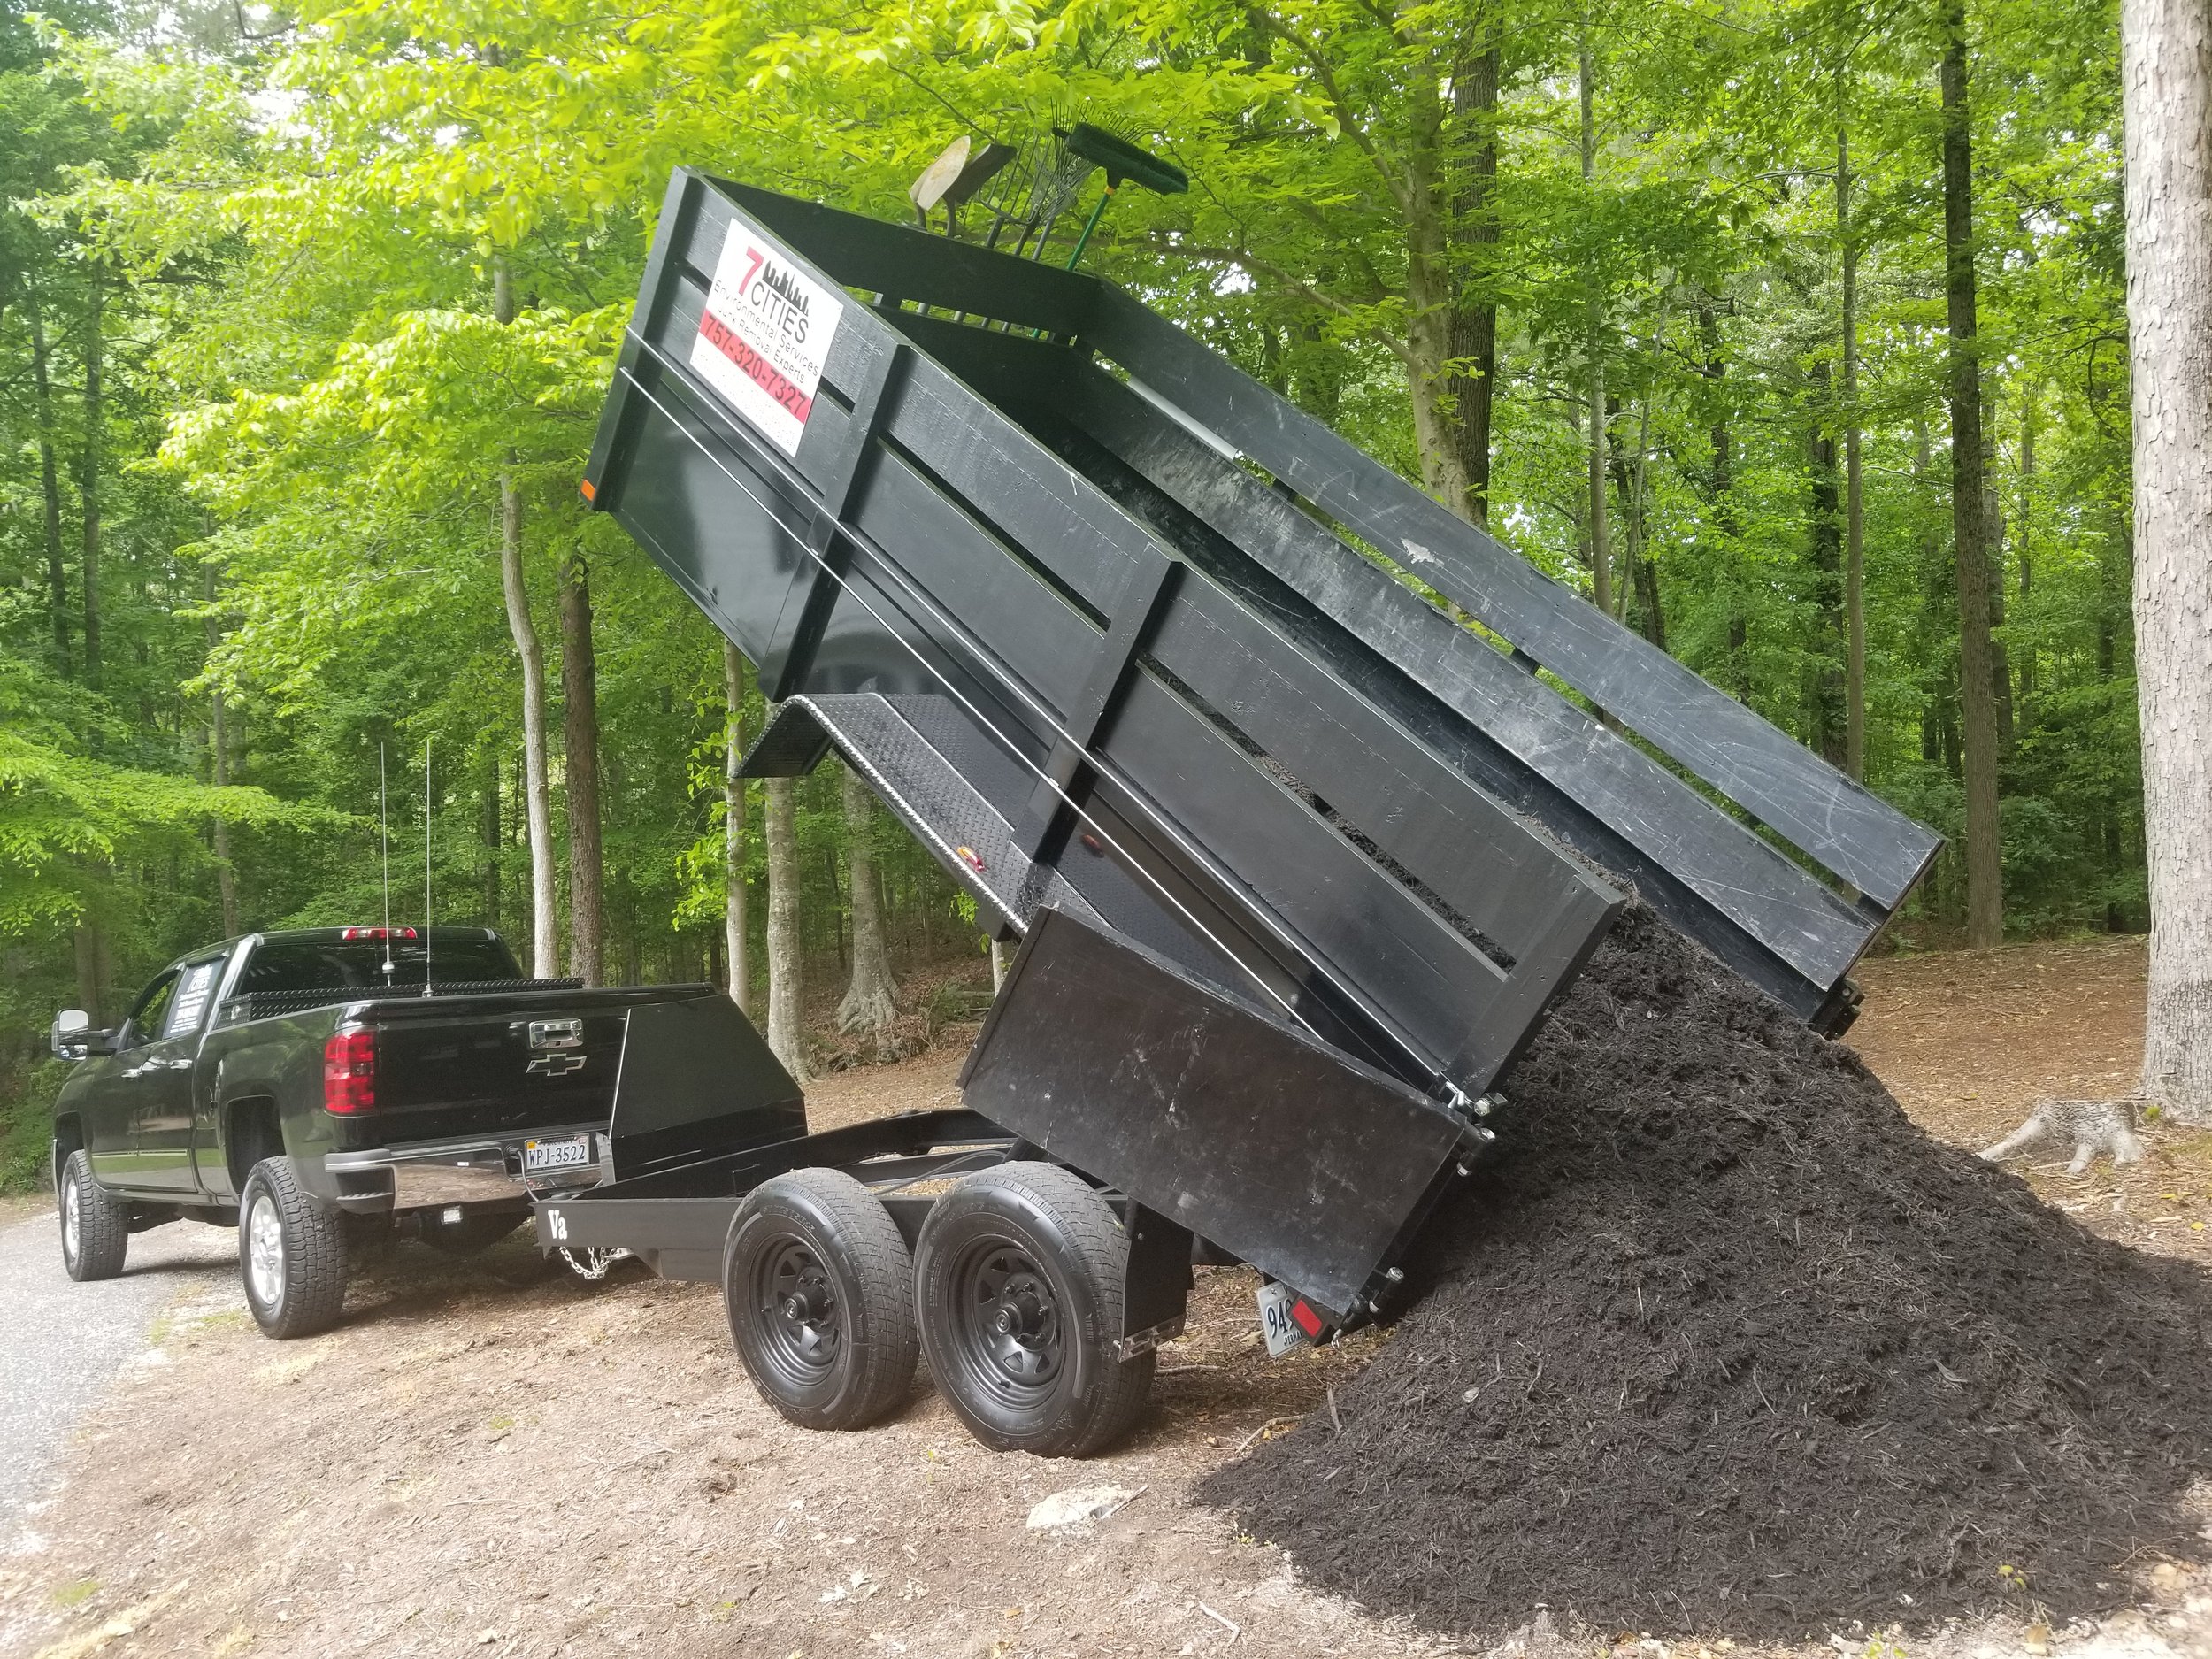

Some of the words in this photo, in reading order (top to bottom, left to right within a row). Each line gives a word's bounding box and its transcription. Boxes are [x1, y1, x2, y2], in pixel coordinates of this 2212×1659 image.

[738, 245, 764, 297] 7
[713, 278, 778, 340] Environmental
[779, 334, 819, 378] Services
[750, 280, 810, 344] CITIES
[705, 314, 806, 417] 757-320-7327
[739, 319, 772, 355] Removal
[772, 349, 805, 384] Experts
[528, 1144, 586, 1166] WPJ-3522
[548, 1210, 568, 1240] Va
